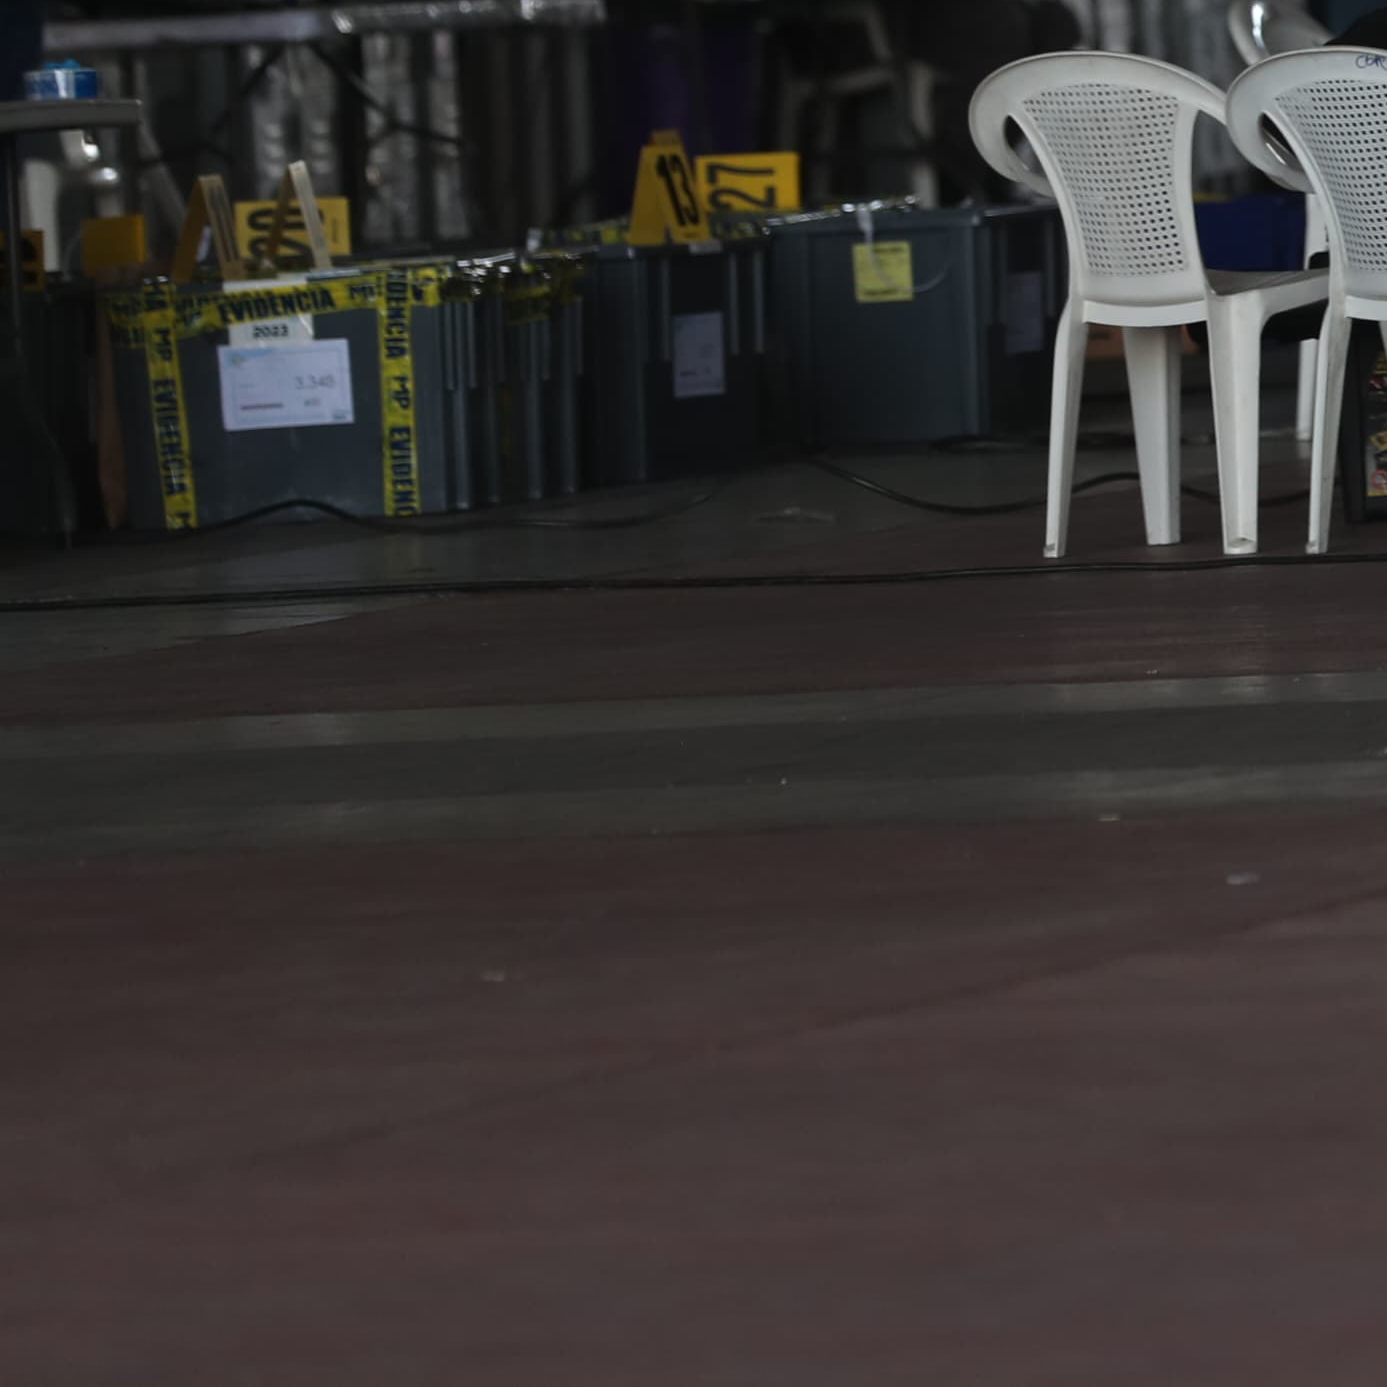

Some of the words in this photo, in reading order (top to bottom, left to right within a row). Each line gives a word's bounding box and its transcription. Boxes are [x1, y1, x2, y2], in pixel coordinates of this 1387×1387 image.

[656, 154, 700, 226] 13
[707, 163, 775, 212] 27
[217, 286, 335, 323] EVIDENCIA
[252, 324, 289, 339] 2023
[391, 374, 410, 411] MP
[153, 379, 189, 496] EVIDENCIA
